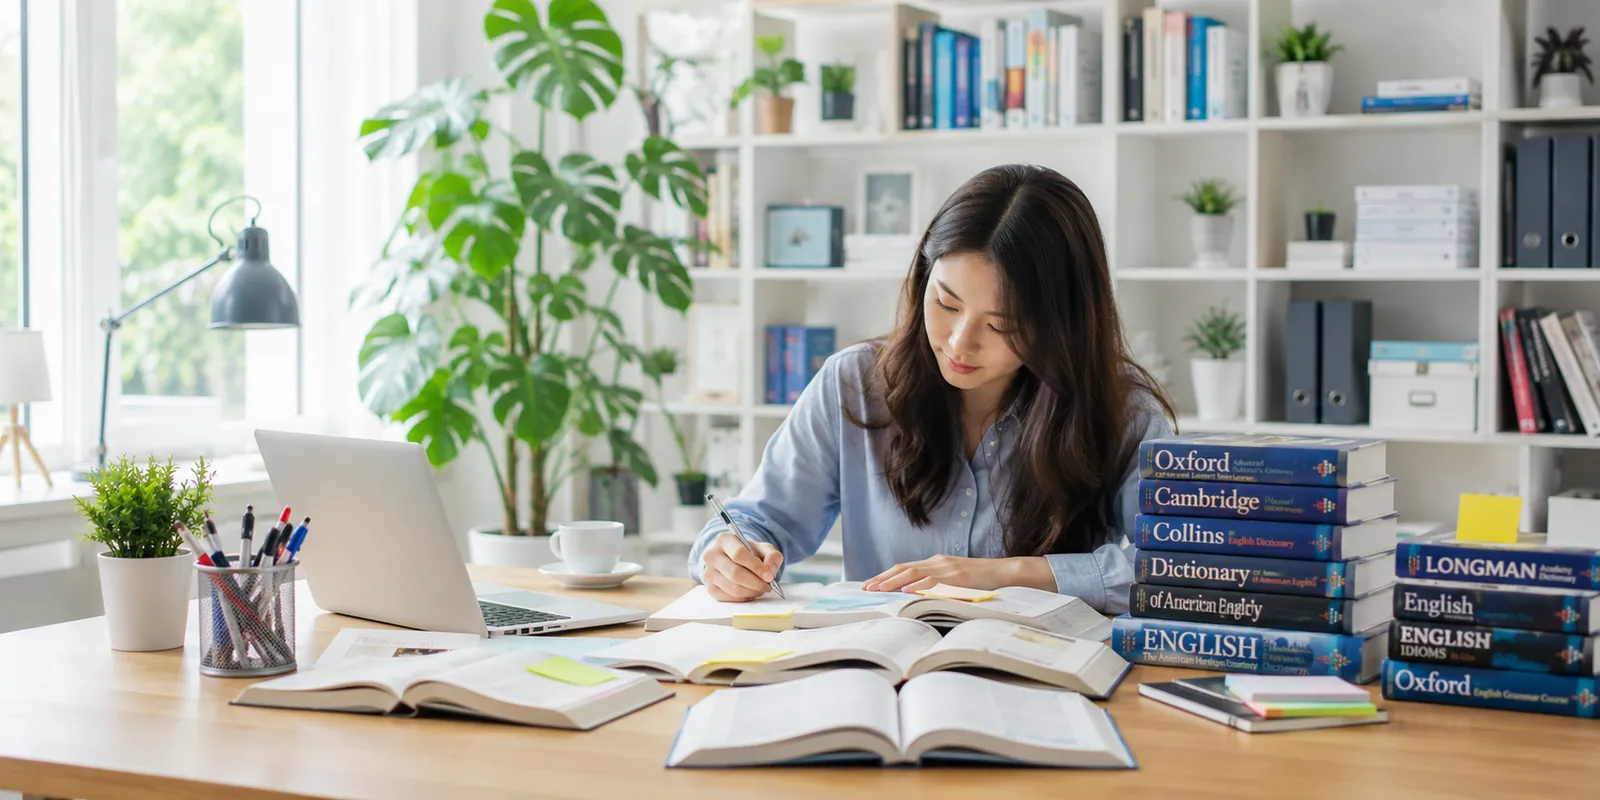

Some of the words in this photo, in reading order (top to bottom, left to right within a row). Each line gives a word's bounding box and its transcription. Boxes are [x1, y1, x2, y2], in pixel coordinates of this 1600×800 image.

[1154, 449, 1230, 473] Oxford
[1154, 487, 1260, 515] Cambridge
[1153, 522, 1225, 545] Collins
[1150, 557, 1251, 588] Dictionary
[1426, 556, 1537, 580] LONGMAN
[1150, 591, 1164, 609] of
[1404, 592, 1473, 617] English
[1143, 628, 1258, 659] ENGLISH
[1400, 626, 1492, 649] ENGLISH
[1400, 644, 1447, 659] IDIOMS
[1394, 668, 1472, 696] Oxford
